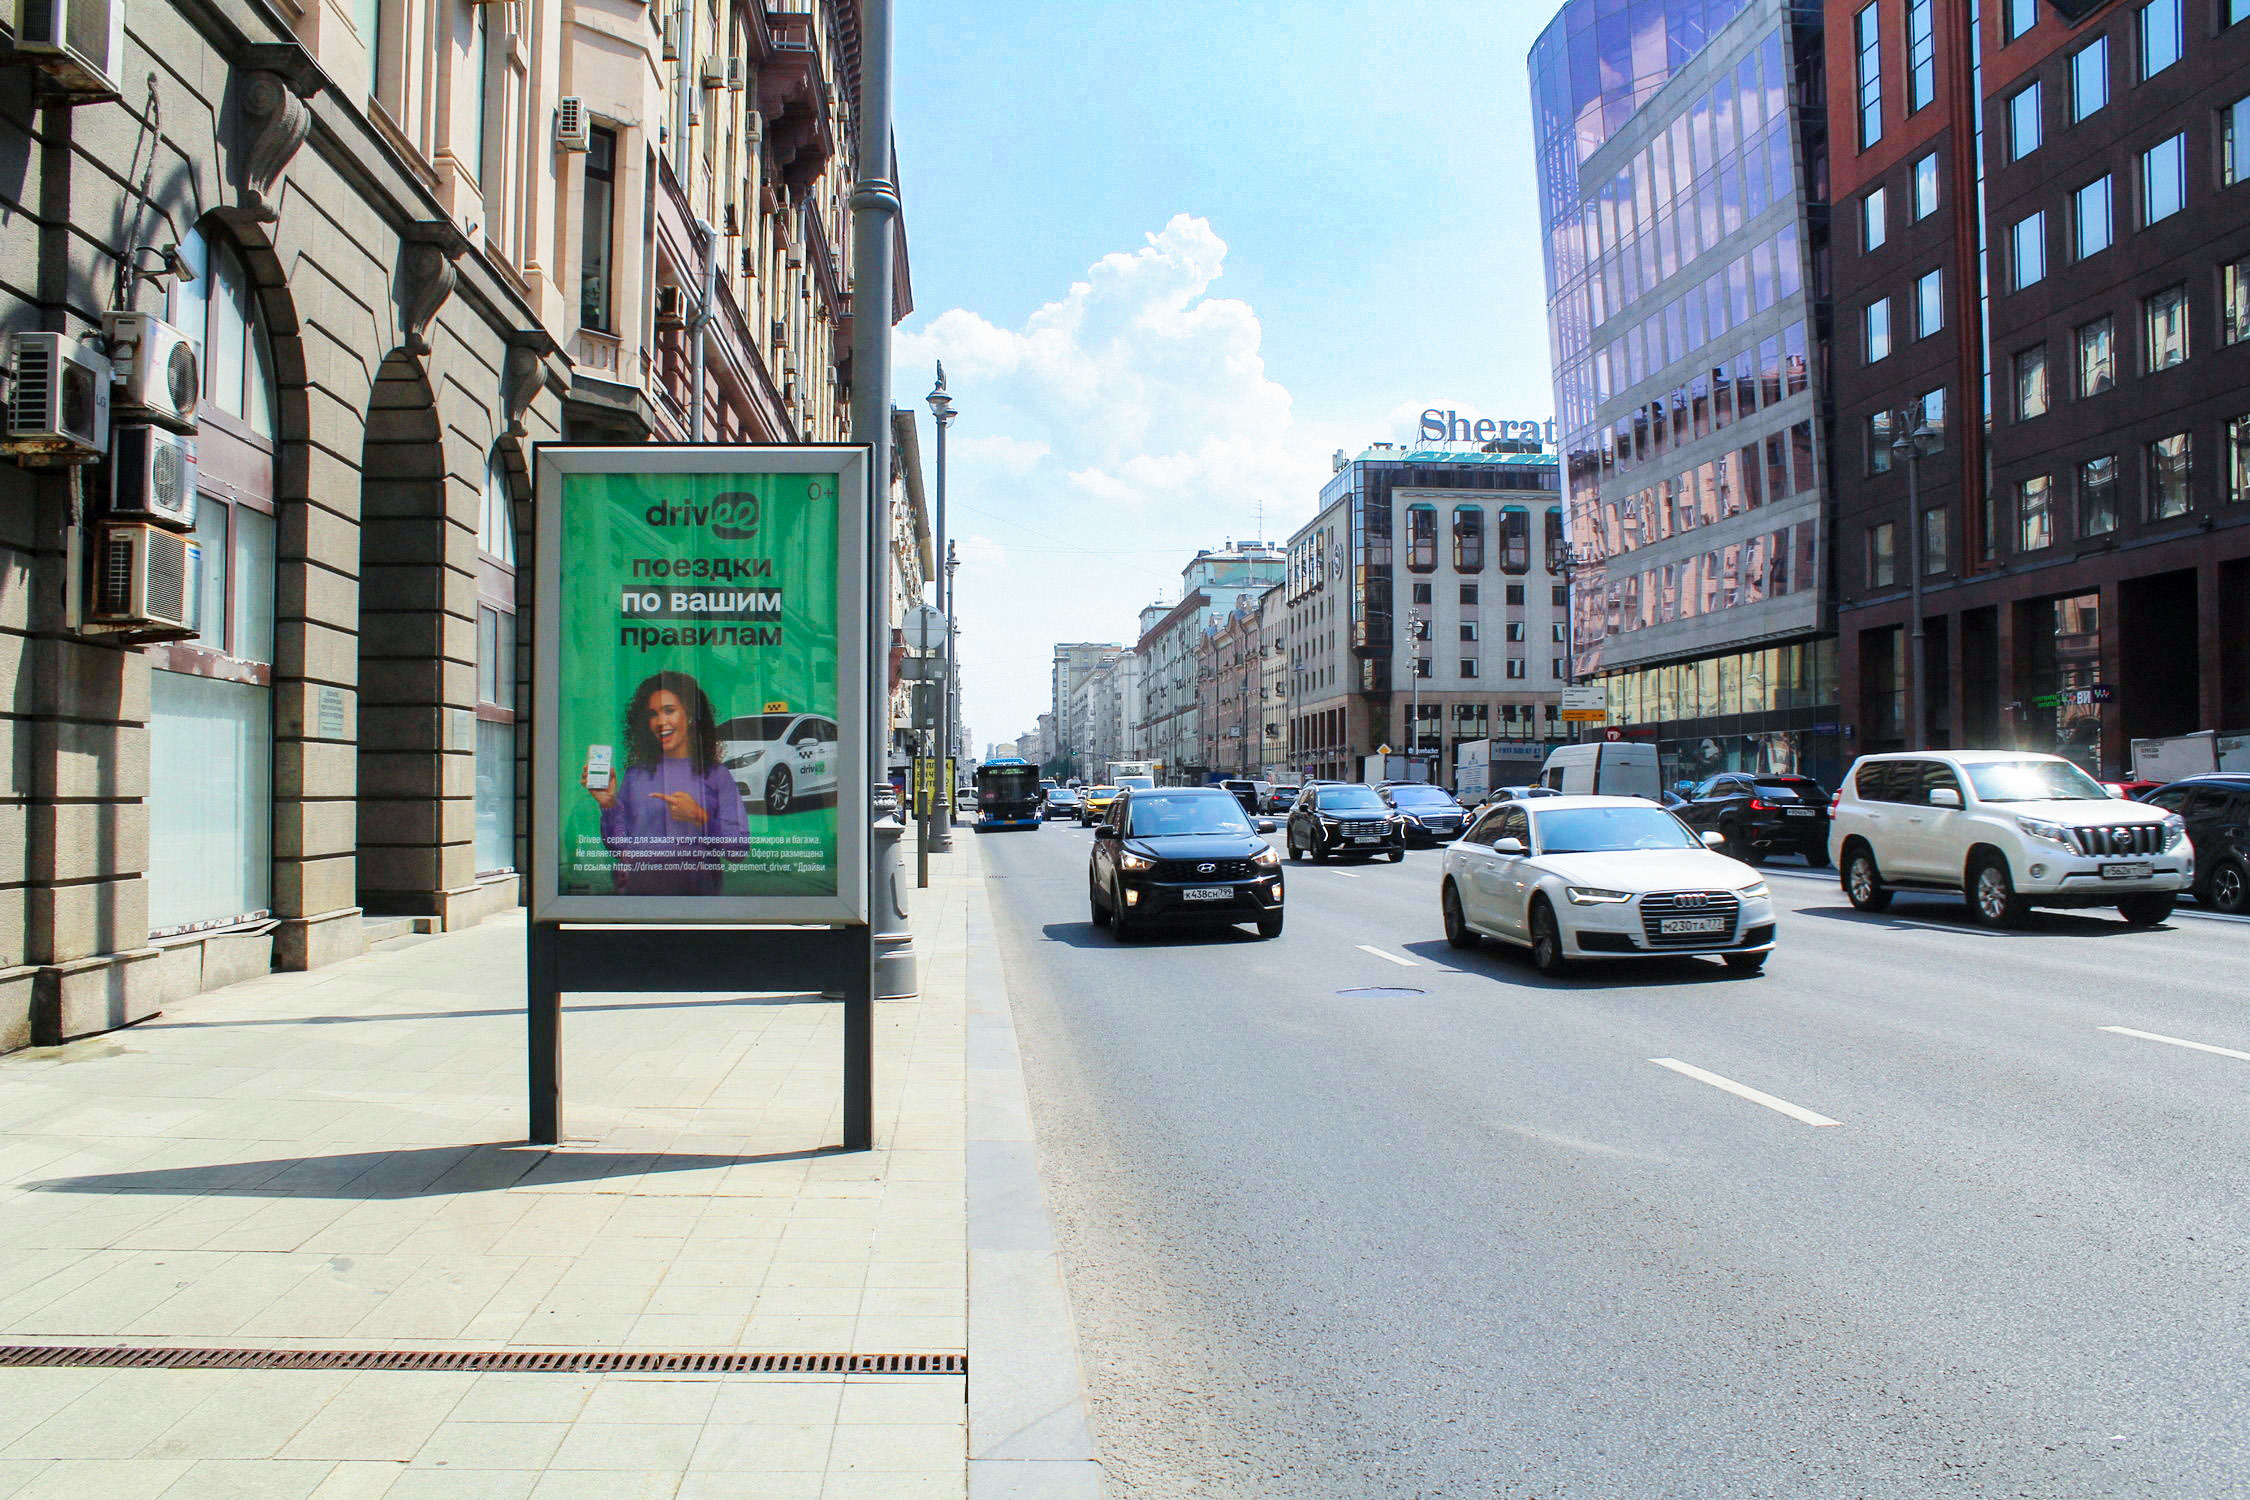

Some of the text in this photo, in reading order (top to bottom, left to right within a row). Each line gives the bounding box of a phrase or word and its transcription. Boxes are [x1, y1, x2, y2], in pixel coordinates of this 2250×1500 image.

[807, 482, 834, 500] 0+
[632, 558, 772, 582] поездки
[622, 592, 781, 612] по вашим
[620, 627, 782, 653] правилам
[578, 835, 601, 844] Drivee
[606, 836, 633, 845] сервис
[634, 836, 649, 844] для
[649, 836, 675, 844] заказа
[676, 837, 697, 845] услуг
[698, 836, 738, 846] перевозки
[739, 836, 785, 846] пассажиров
[576, 848, 585, 857] Не
[586, 850, 621, 858] является
[622, 850, 676, 859] перевозчиком
[692, 848, 726, 859] службой
[751, 848, 779, 859] Оферта
[780, 850, 824, 859] размещена
[573, 863, 582, 871] по
[583, 862, 612, 871] ссылке
